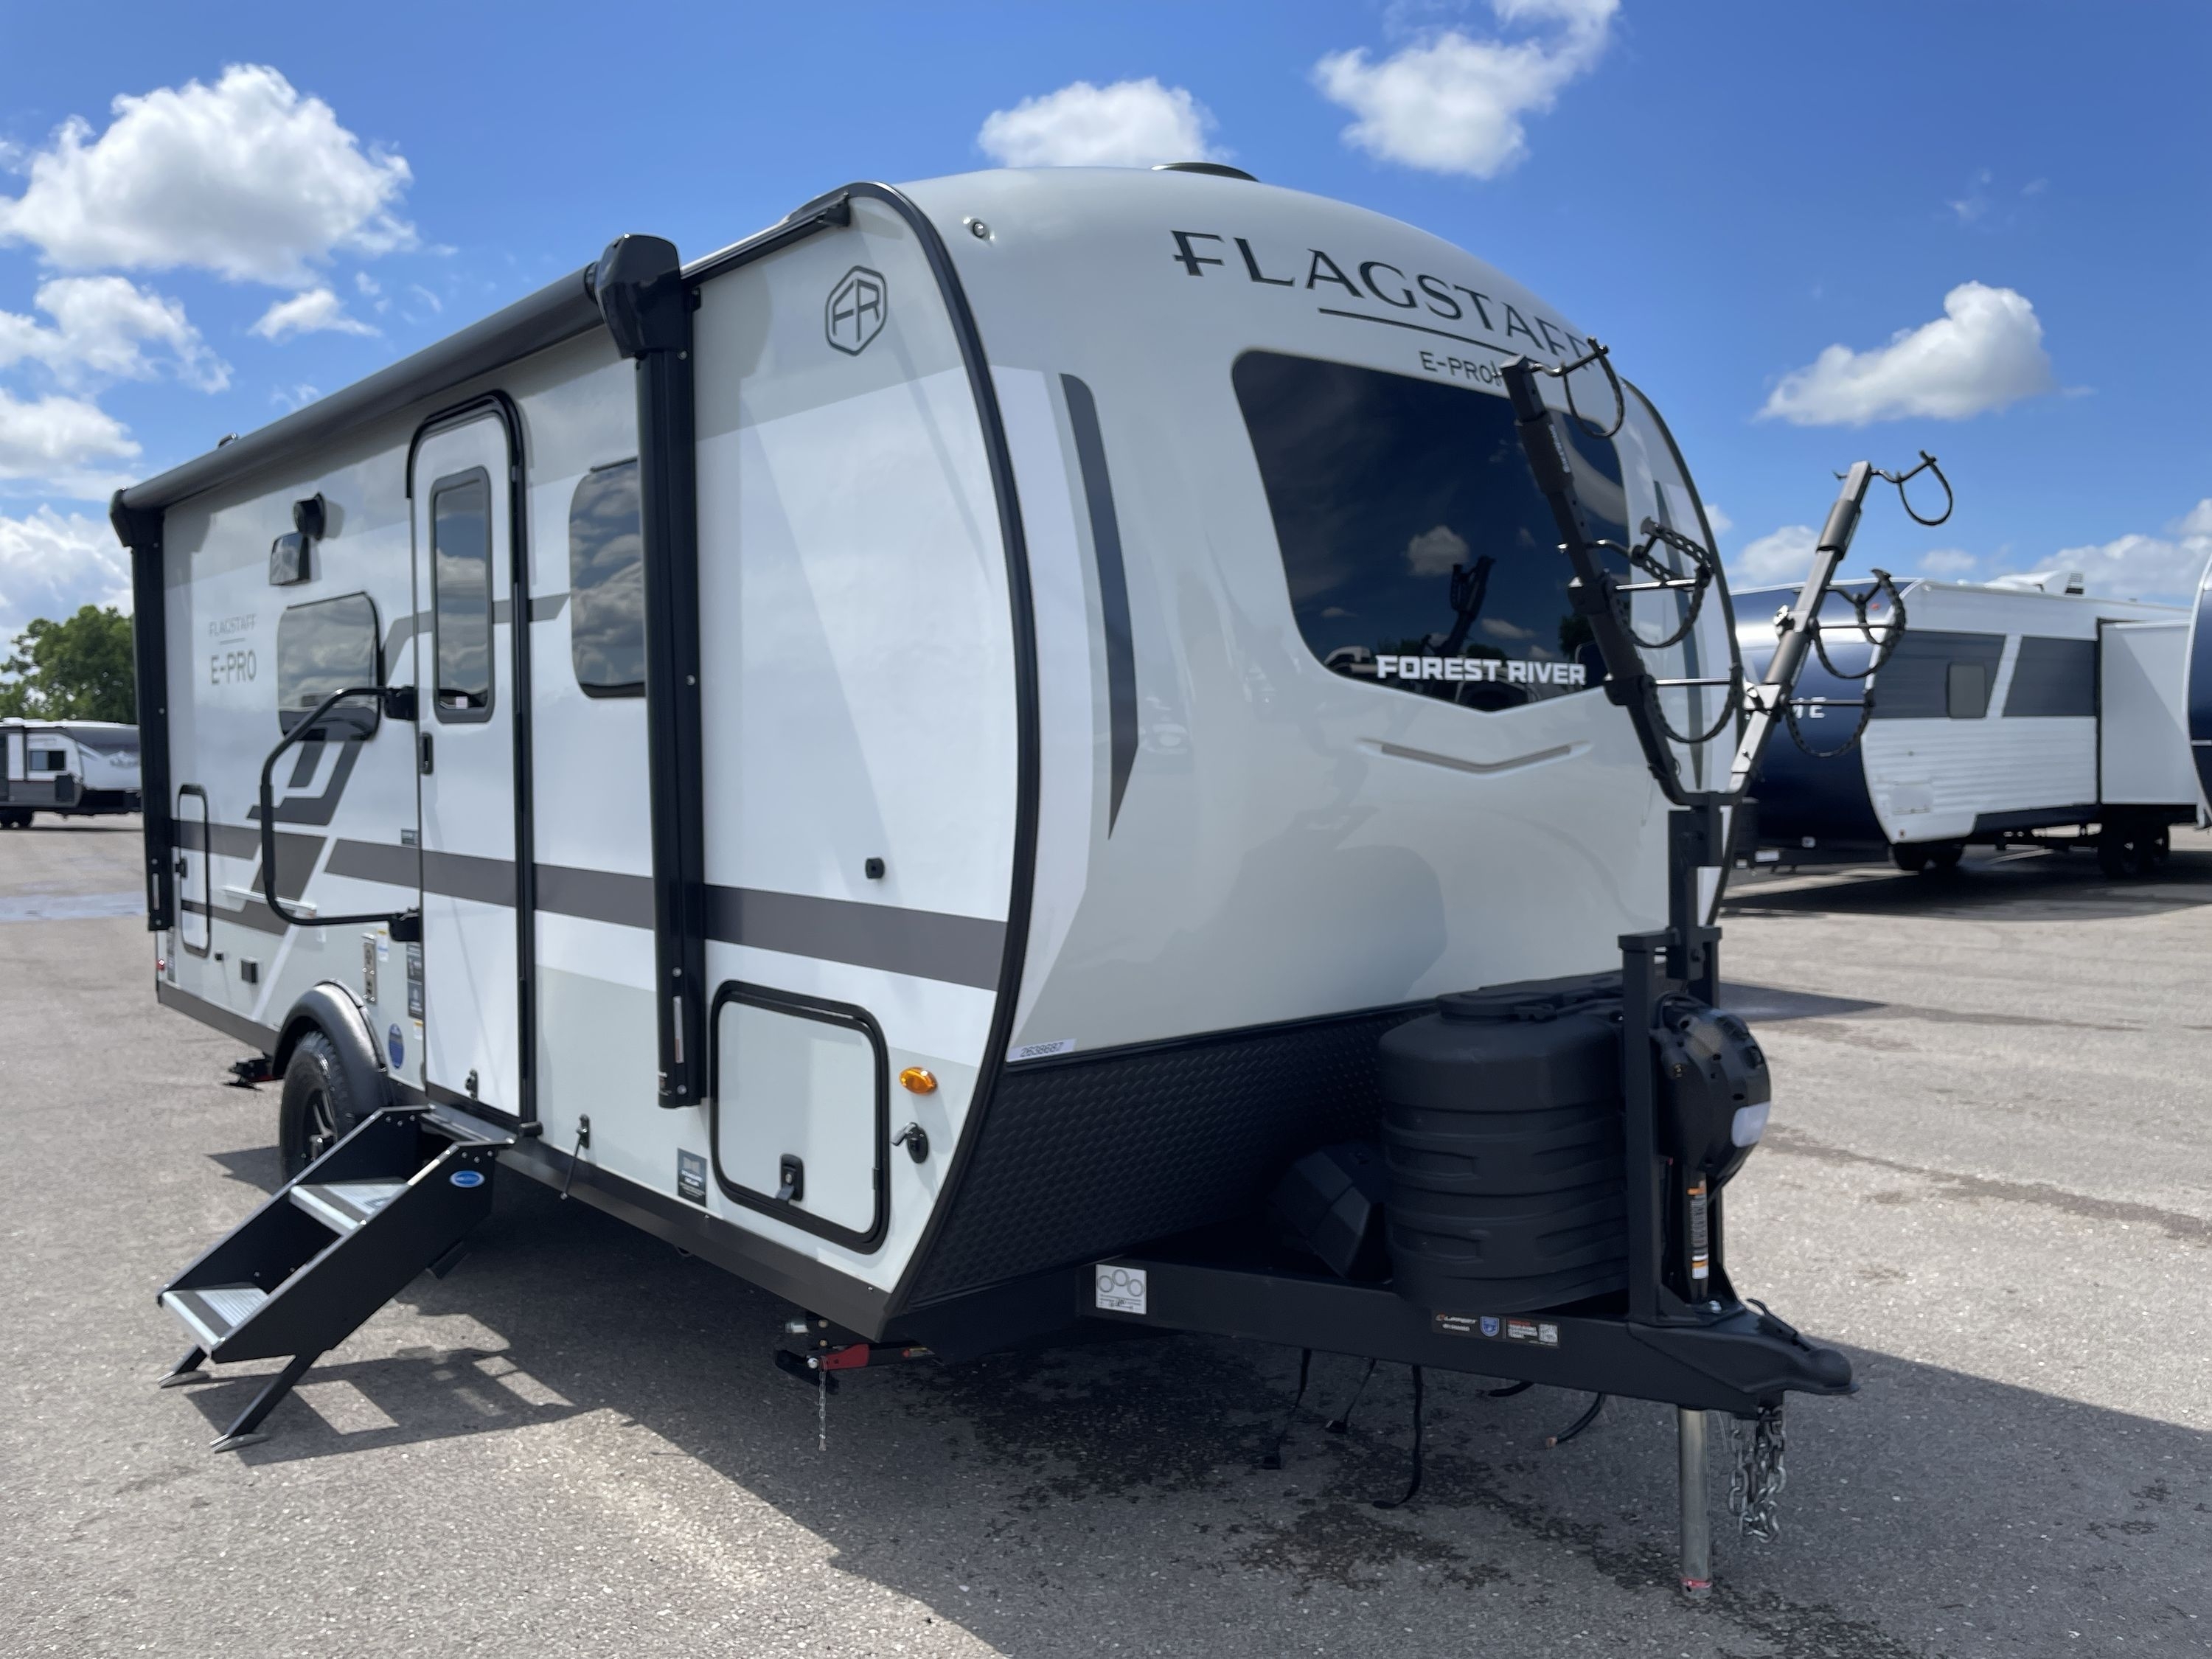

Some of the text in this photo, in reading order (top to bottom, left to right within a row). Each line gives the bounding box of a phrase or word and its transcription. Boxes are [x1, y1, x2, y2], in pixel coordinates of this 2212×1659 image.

[1171, 230, 1594, 371] FLAGSTAFF
[1418, 350, 1493, 385] E-PRO
[211, 650, 257, 685] E-PRO
[1375, 654, 1587, 686] FOREST RIVER
